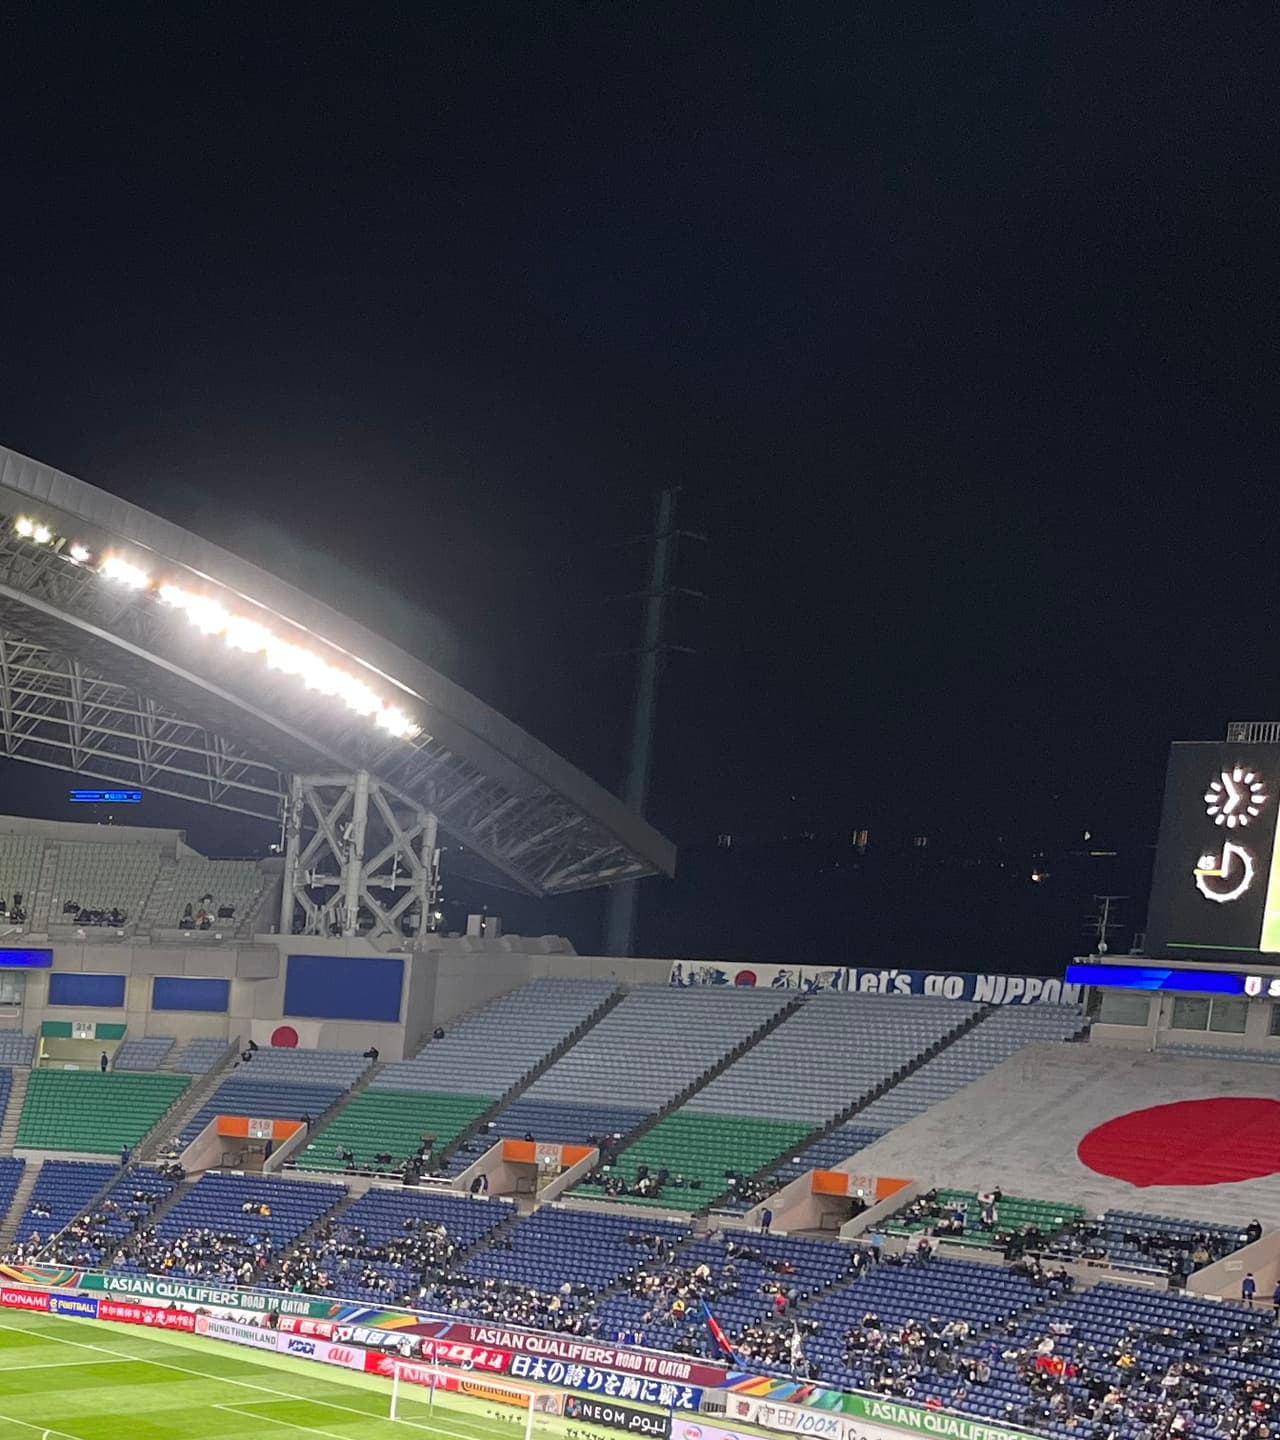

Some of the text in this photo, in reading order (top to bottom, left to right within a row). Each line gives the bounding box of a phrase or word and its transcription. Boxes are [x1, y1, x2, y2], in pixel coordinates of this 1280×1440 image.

[2, 1292, 47, 1307] KONAMI
[110, 1278, 154, 1294] ASIAN
[156, 1283, 239, 1305] QUALIFIERS
[208, 1321, 230, 1335] HUNG
[288, 1340, 316, 1356] KDDI
[327, 1349, 354, 1363] au
[476, 1328, 524, 1350] ASIAN
[528, 1337, 613, 1365] QUALIFIERS
[616, 1351, 642, 1369] ROAD
[644, 1357, 656, 1373] TO
[658, 1360, 691, 1379] QATAR
[583, 1404, 625, 1423] NEOM
[871, 1401, 921, 1428] ASIAN
[629, 1414, 666, 1434] نيوم
